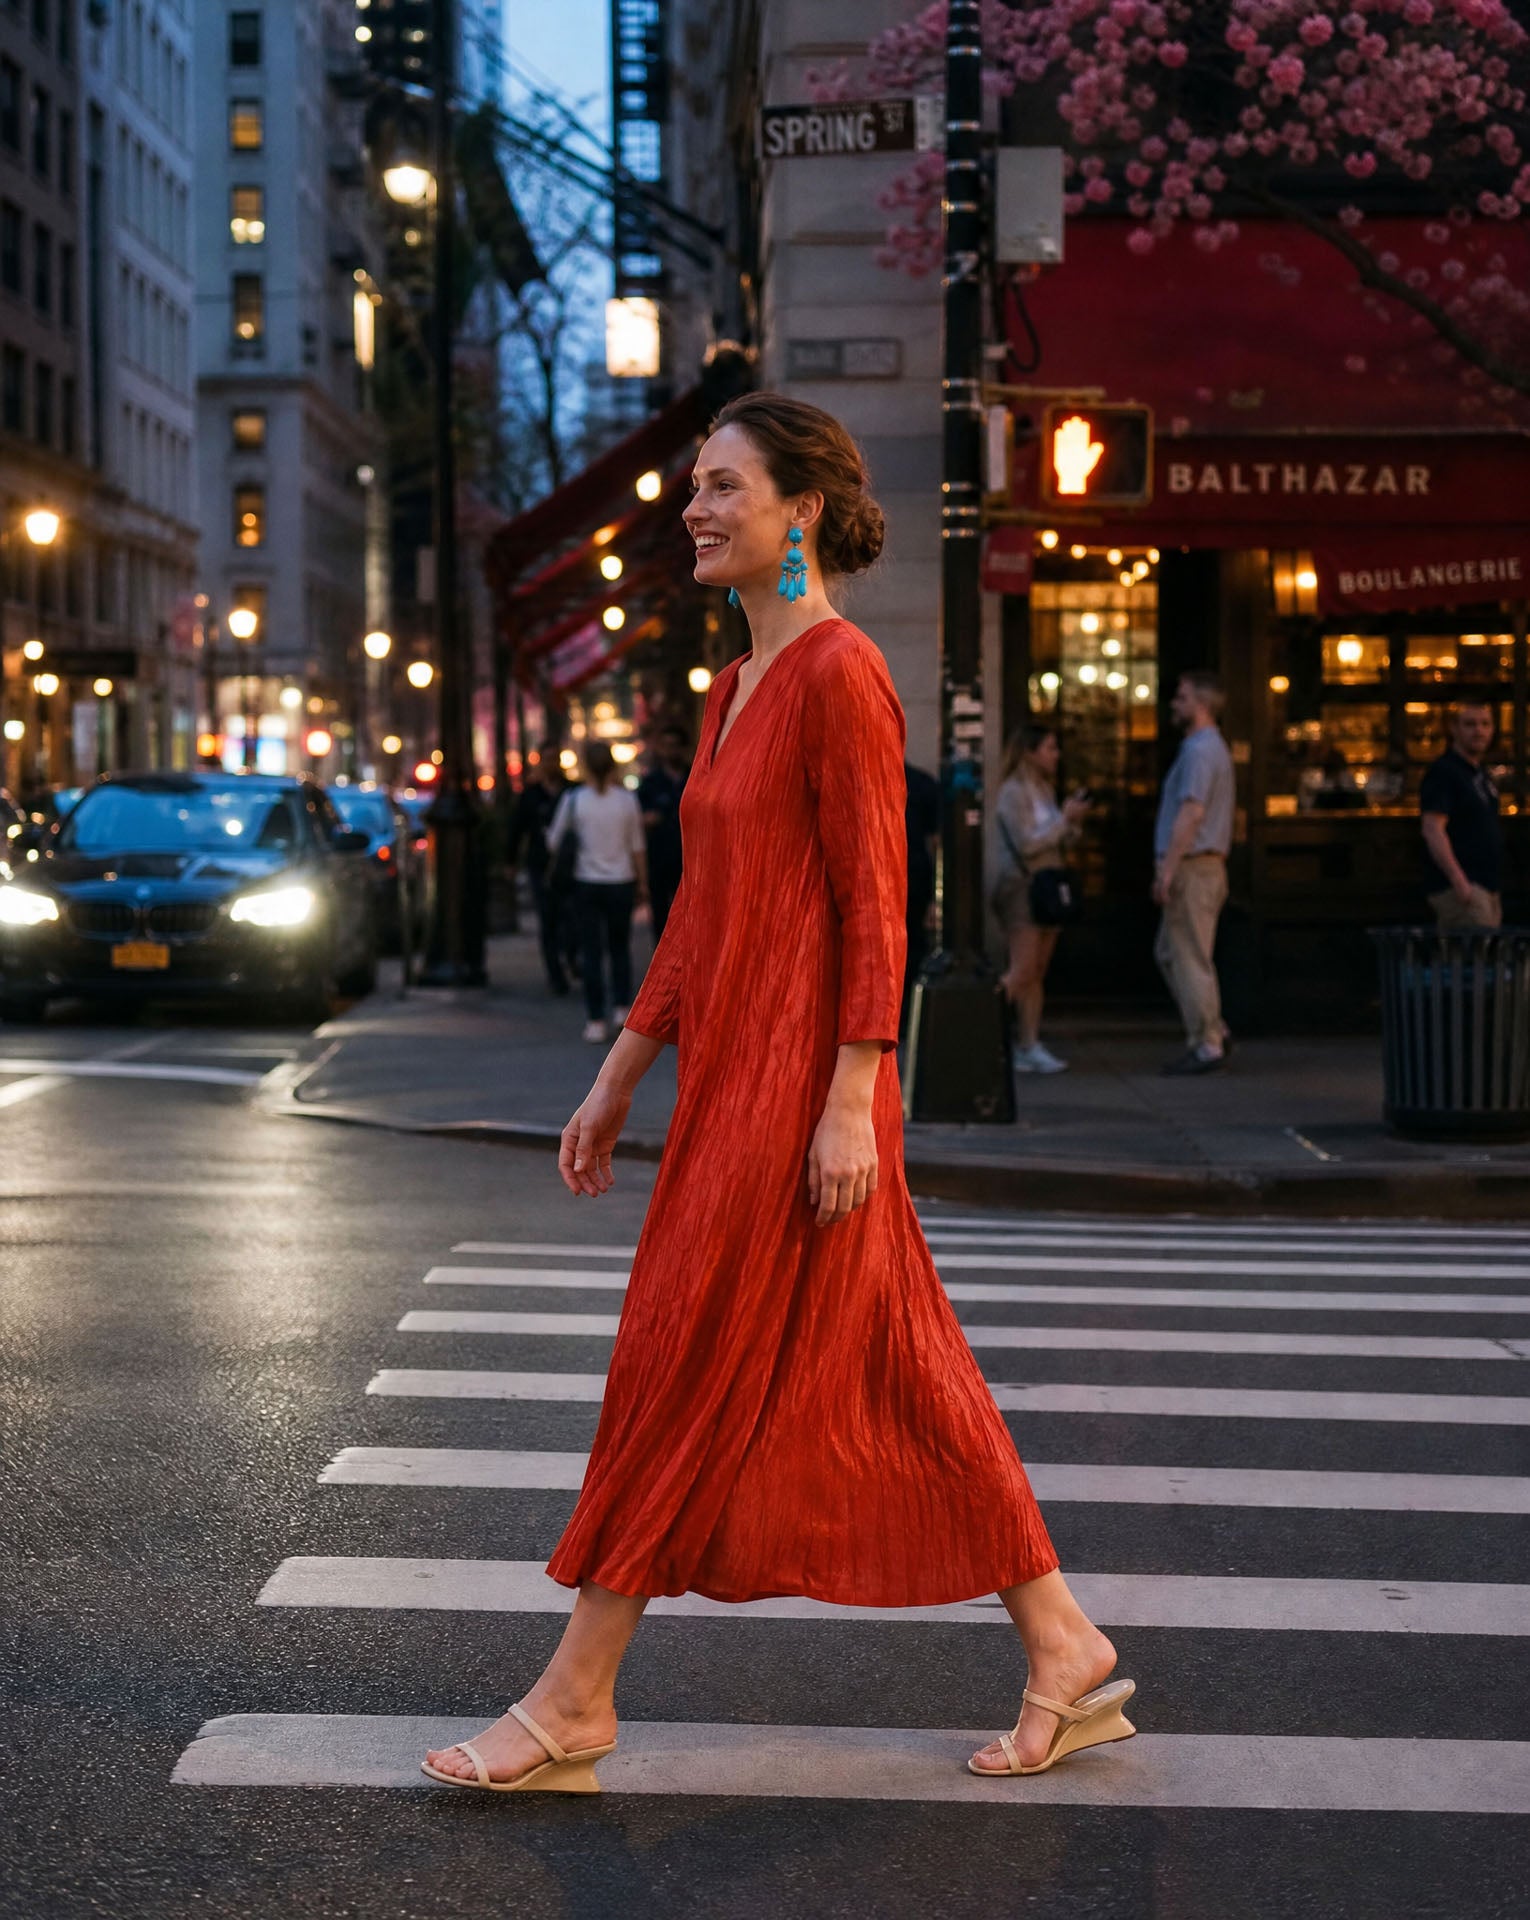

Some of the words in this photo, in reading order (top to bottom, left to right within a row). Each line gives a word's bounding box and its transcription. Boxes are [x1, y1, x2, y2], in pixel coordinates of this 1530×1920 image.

[765, 112, 876, 154] SPRING
[1169, 463, 1431, 495] BALTHAZAR
[1339, 557, 1521, 594] BOULANGERIE
